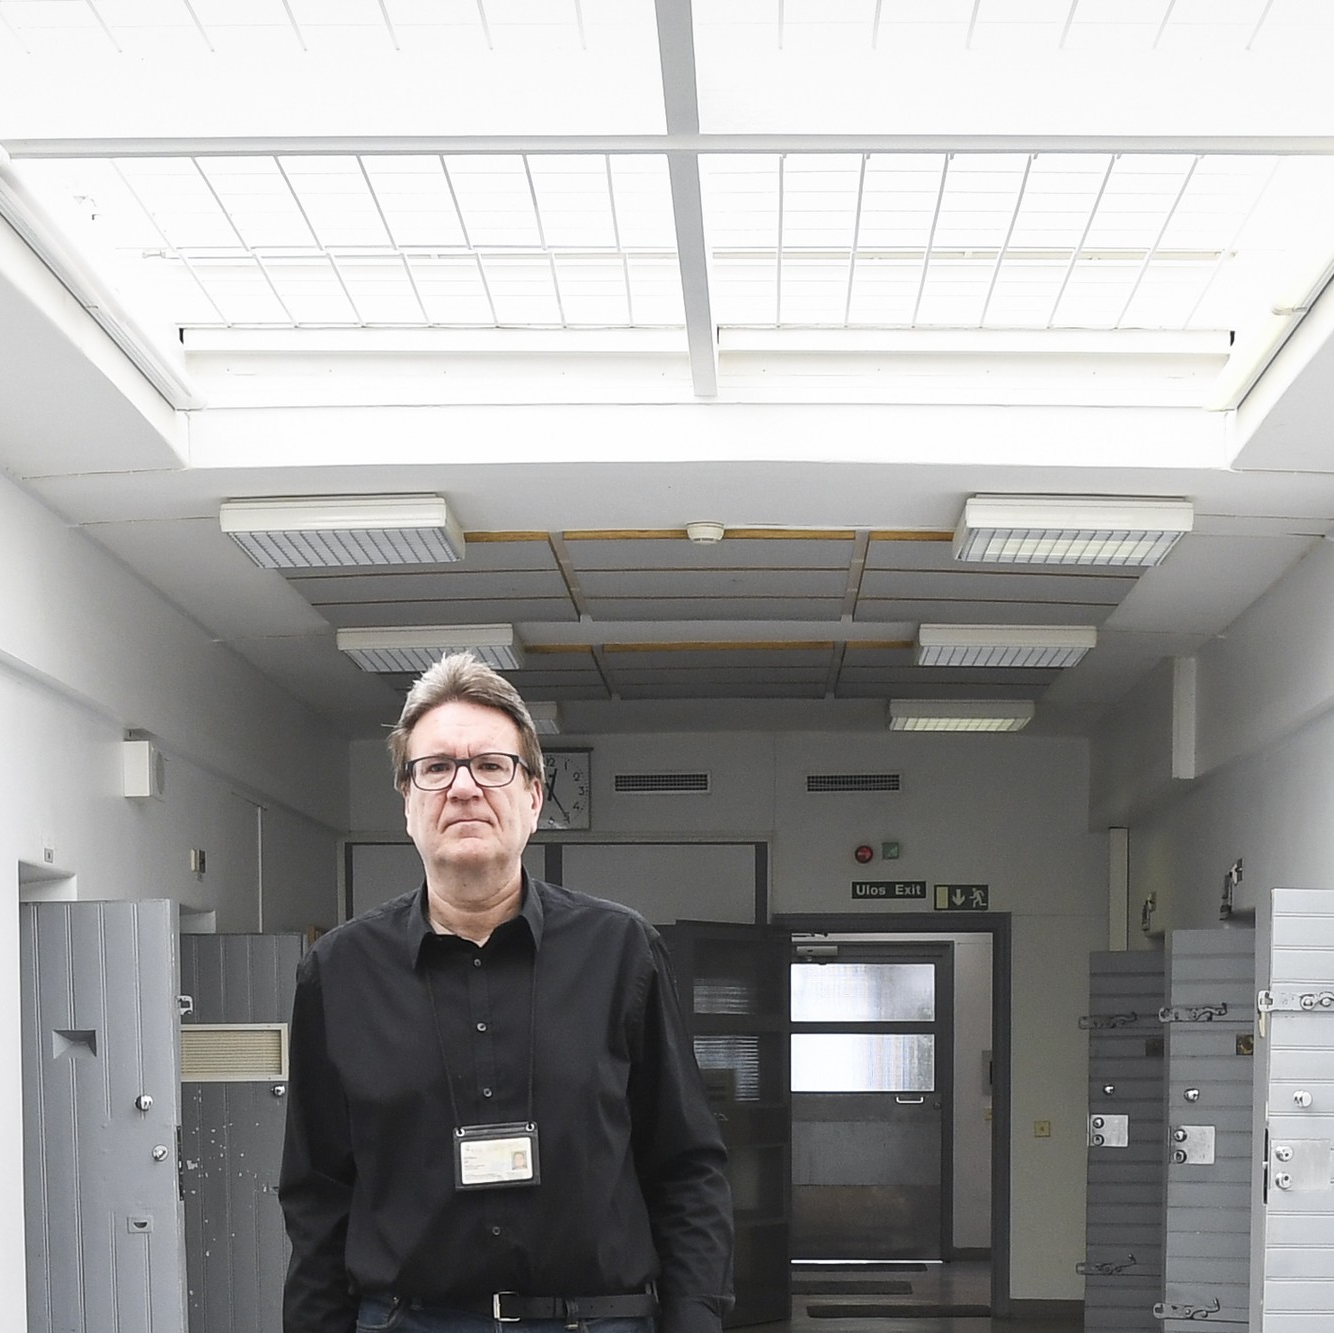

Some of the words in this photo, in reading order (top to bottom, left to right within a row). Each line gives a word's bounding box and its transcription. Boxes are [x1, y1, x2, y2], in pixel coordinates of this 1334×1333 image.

[573, 772, 581, 781] 2
[579, 786, 585, 796] 3
[572, 802, 580, 810] 4
[856, 884, 886, 896] Ulos
[895, 884, 921, 895] Exit
